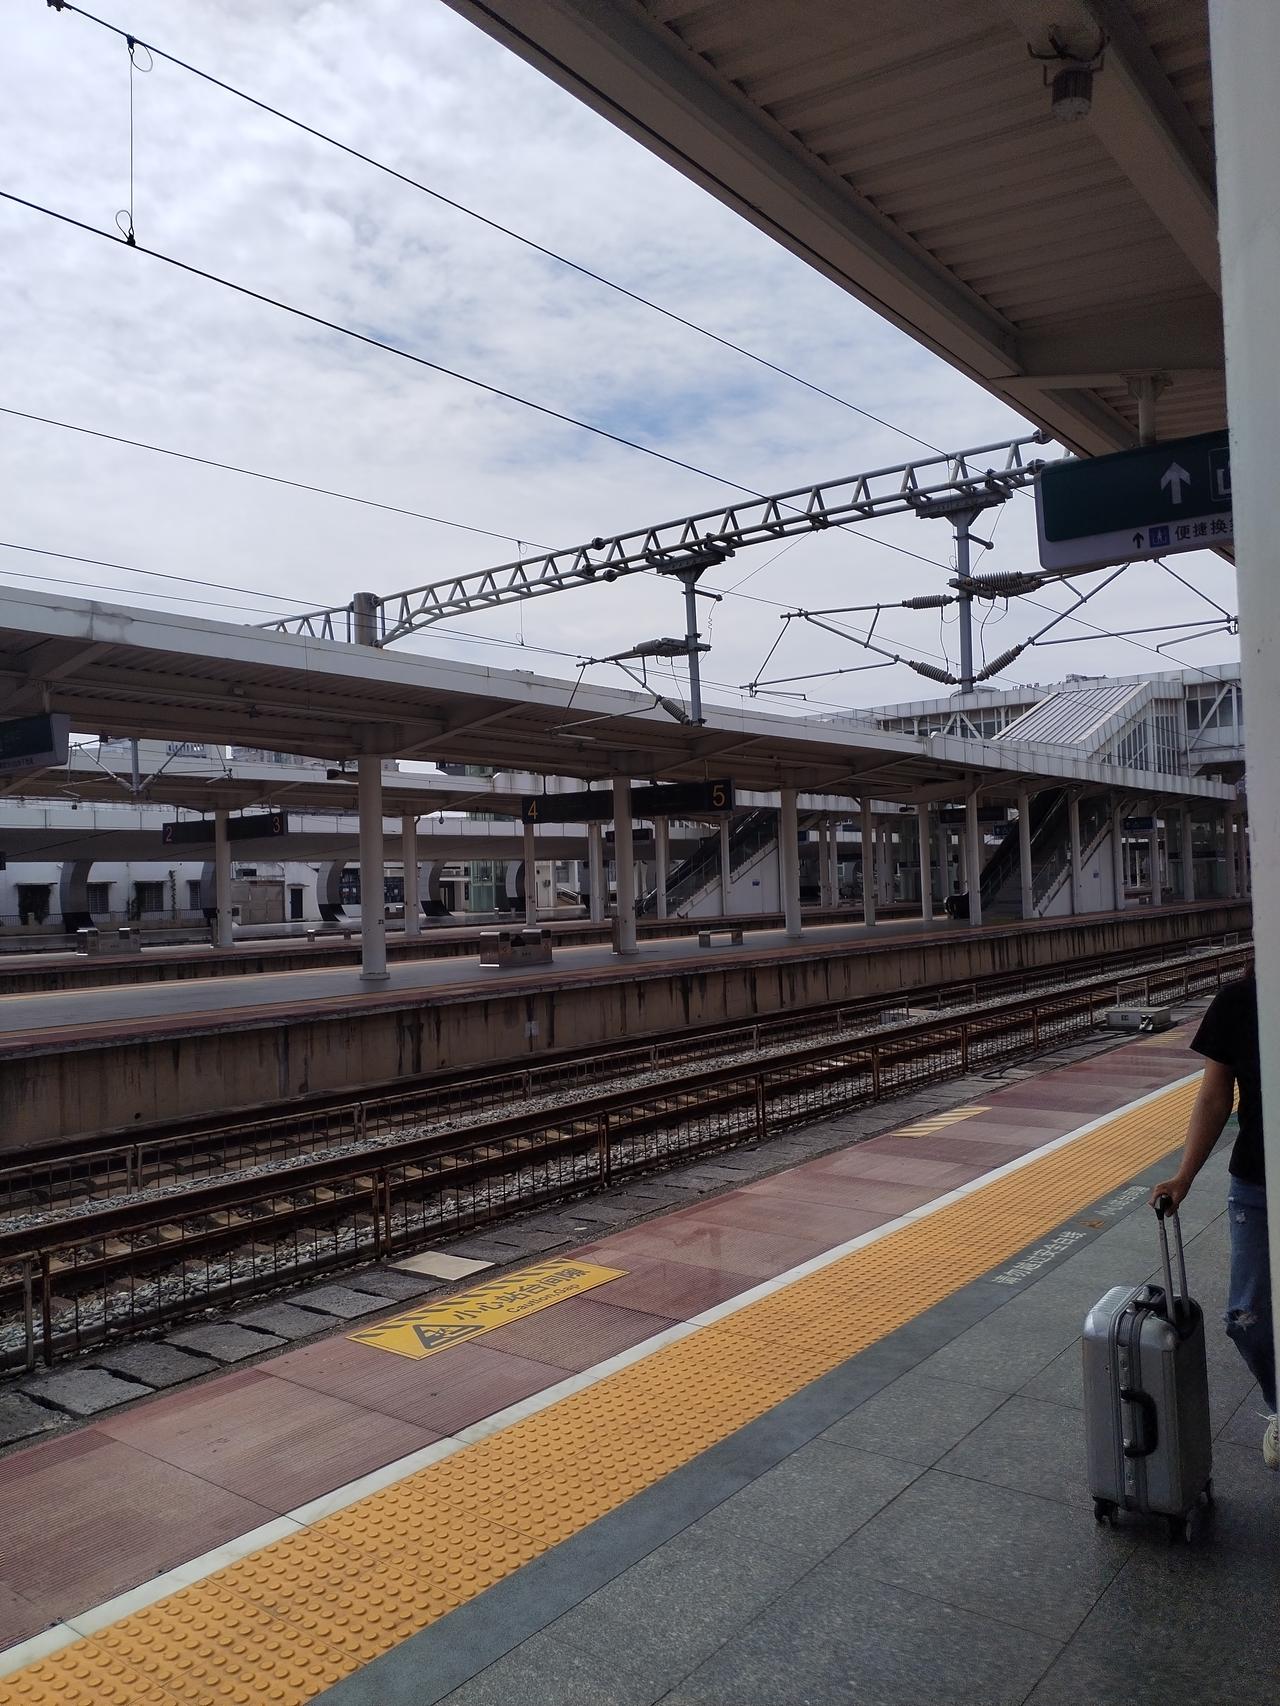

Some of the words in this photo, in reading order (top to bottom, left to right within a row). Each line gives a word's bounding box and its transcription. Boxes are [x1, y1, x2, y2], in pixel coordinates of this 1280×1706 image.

[1176, 518, 1233, 540] 便捷换
[712, 785, 725, 806] 5
[527, 800, 538, 820] 4
[165, 826, 173, 842] 2
[273, 816, 281, 833] 3
[453, 1268, 590, 1320] 小心站台间隙
